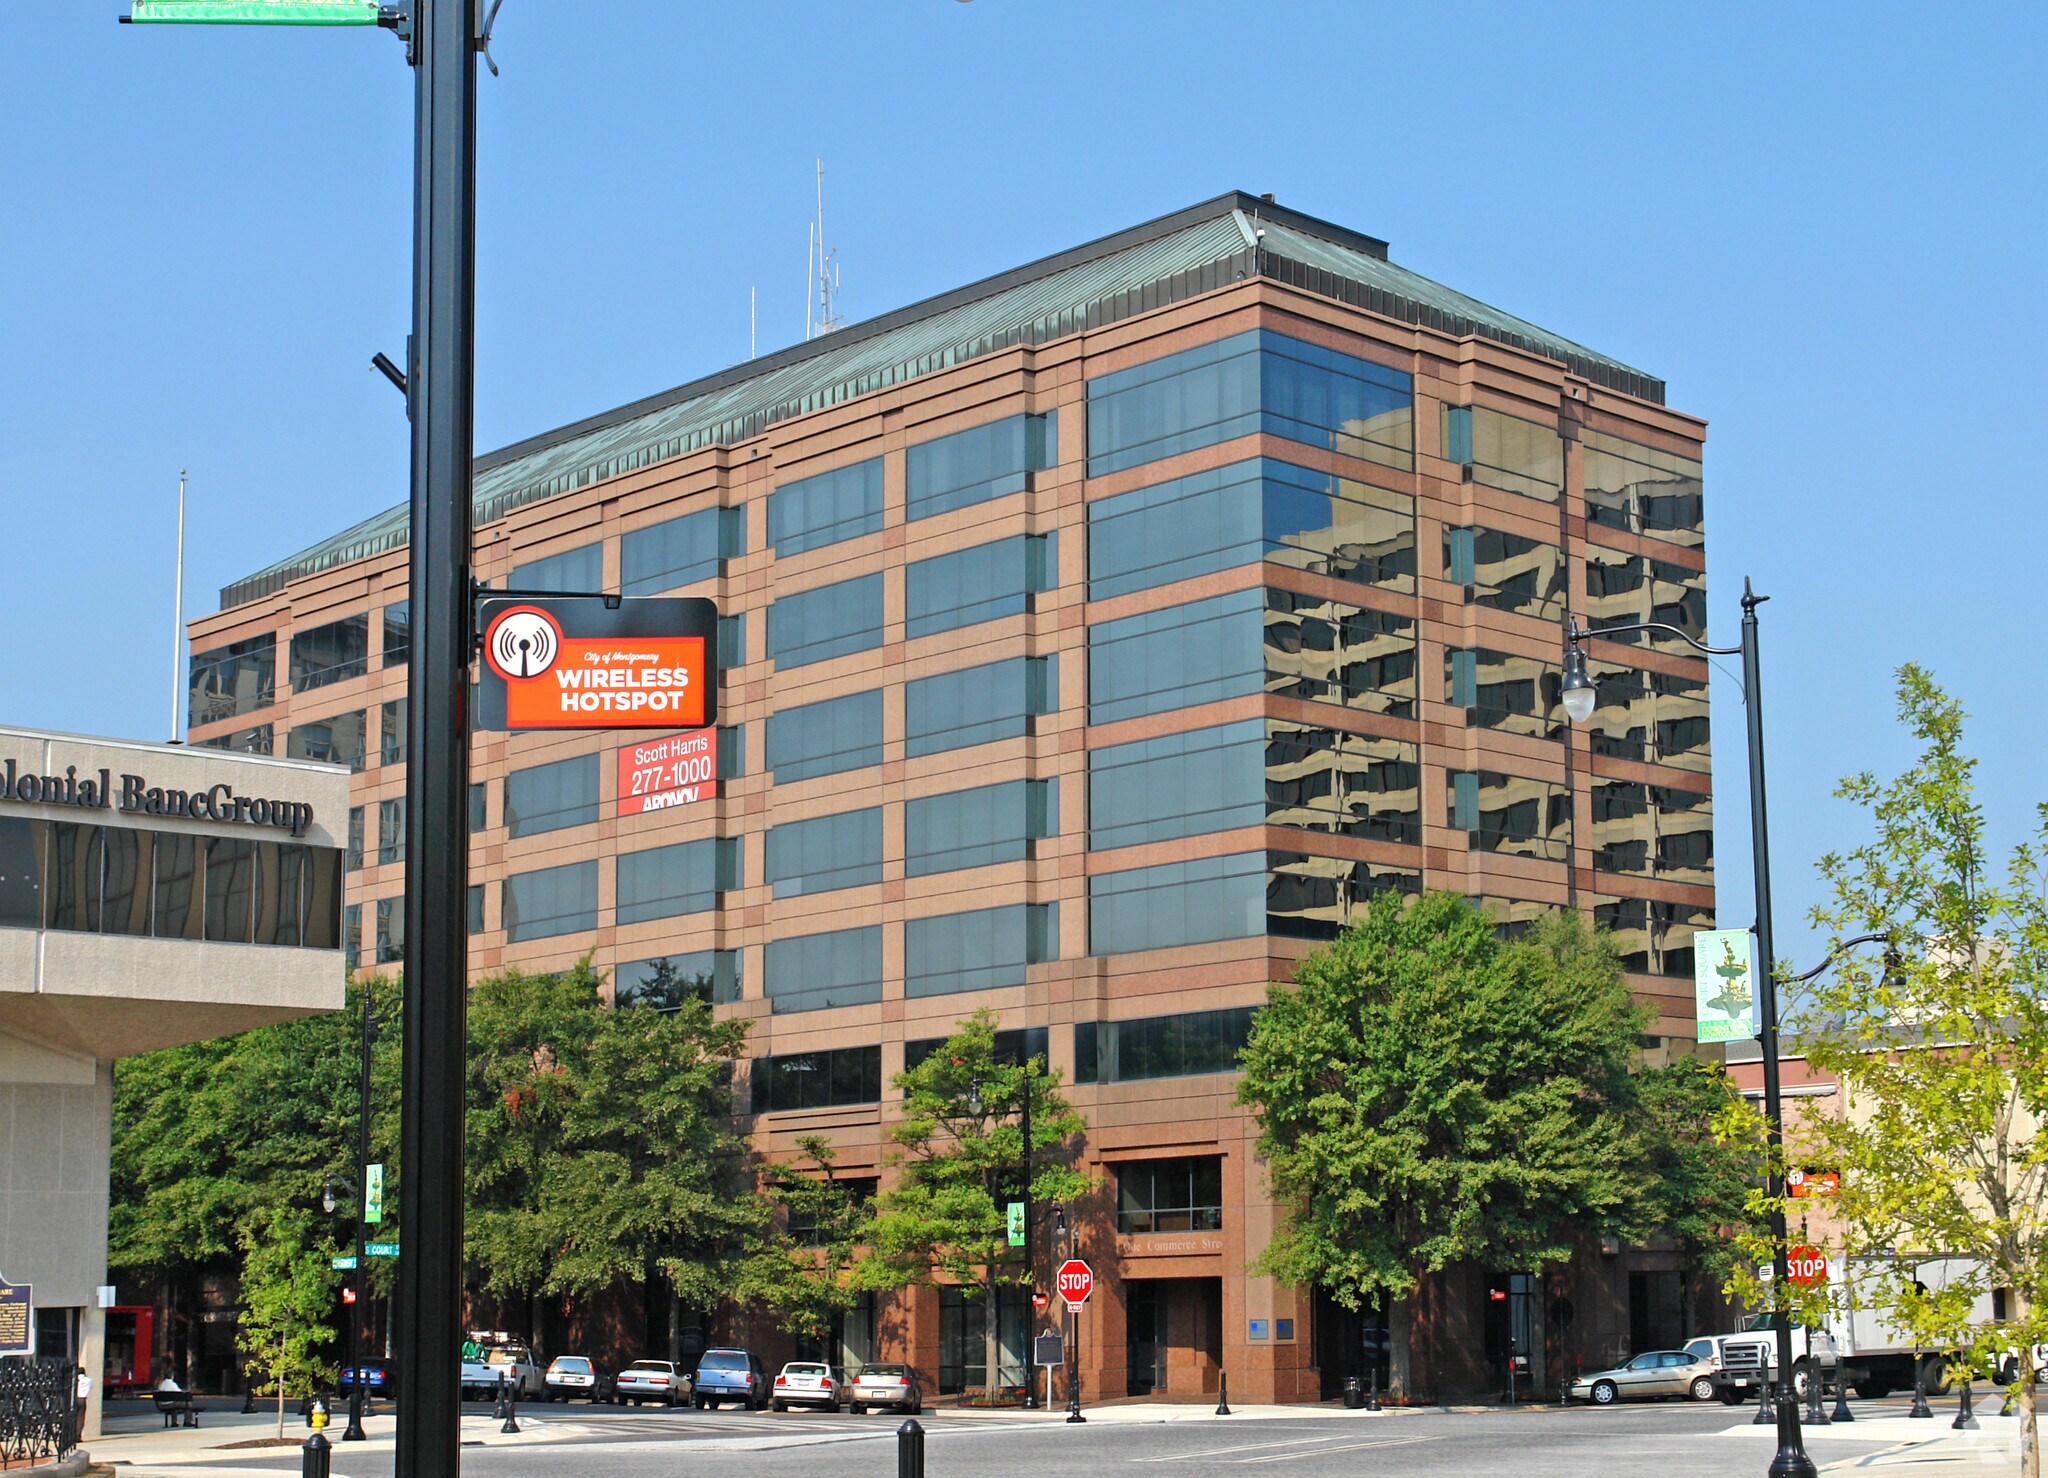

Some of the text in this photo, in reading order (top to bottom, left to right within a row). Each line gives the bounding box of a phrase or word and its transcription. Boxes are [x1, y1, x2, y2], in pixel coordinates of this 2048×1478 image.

[584, 651, 659, 665] City of Montgomery
[556, 668, 689, 688] WIRELESS
[560, 691, 684, 712] HOTSPOT
[635, 734, 708, 765] Scott Harris
[632, 755, 711, 795] 277-1000
[0, 759, 314, 838] lonial BancGroup
[643, 786, 699, 812] ARONOV
[371, 1246, 393, 1255] COURT
[1147, 1240, 1196, 1251] Commerce
[1202, 1238, 1223, 1249] Stre
[1788, 1259, 1824, 1278] STOP
[1060, 1273, 1090, 1290] STOP
[0, 1288, 13, 1296] ARE
